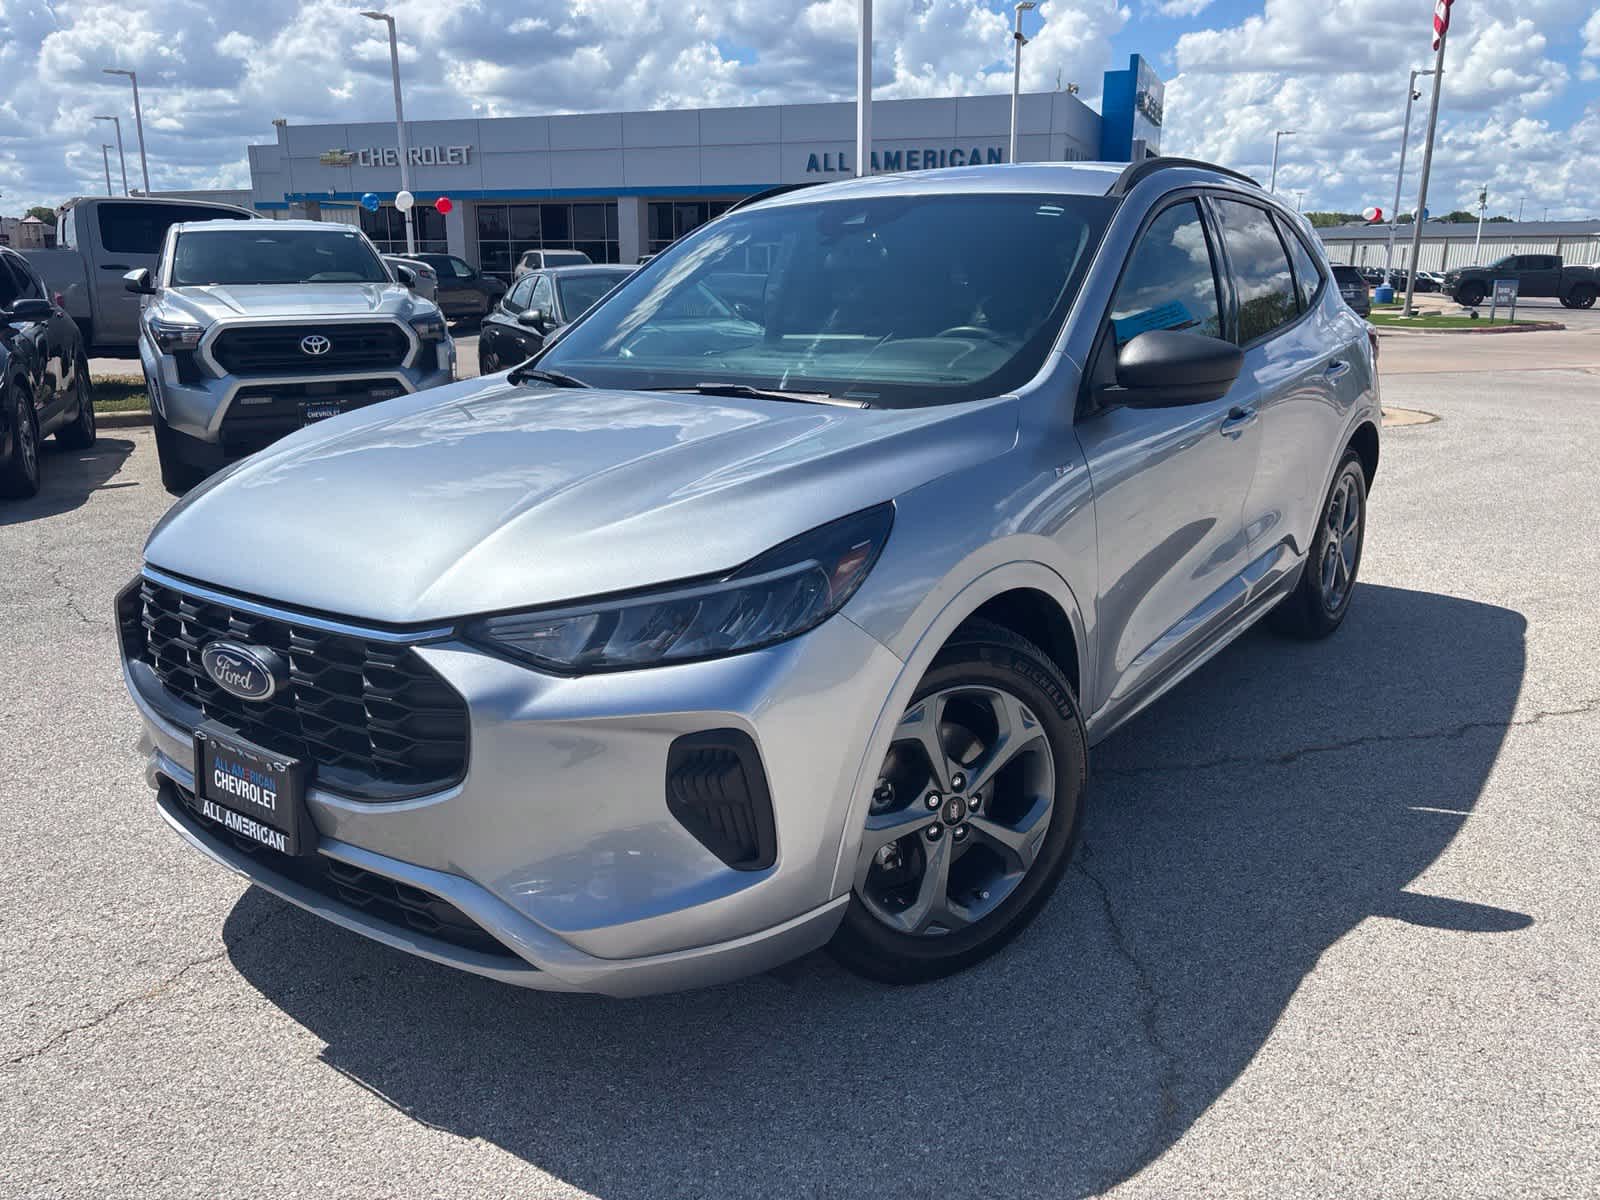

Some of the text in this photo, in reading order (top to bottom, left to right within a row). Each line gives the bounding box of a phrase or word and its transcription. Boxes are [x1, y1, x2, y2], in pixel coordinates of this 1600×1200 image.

[806, 147, 1002, 172] ALL AMERICAN
[214, 654, 253, 690] Ford
[214, 769, 277, 811] CHEVROLET
[215, 756, 276, 793] ALL AMERICAN
[203, 800, 286, 852] ALL AMERICAN
